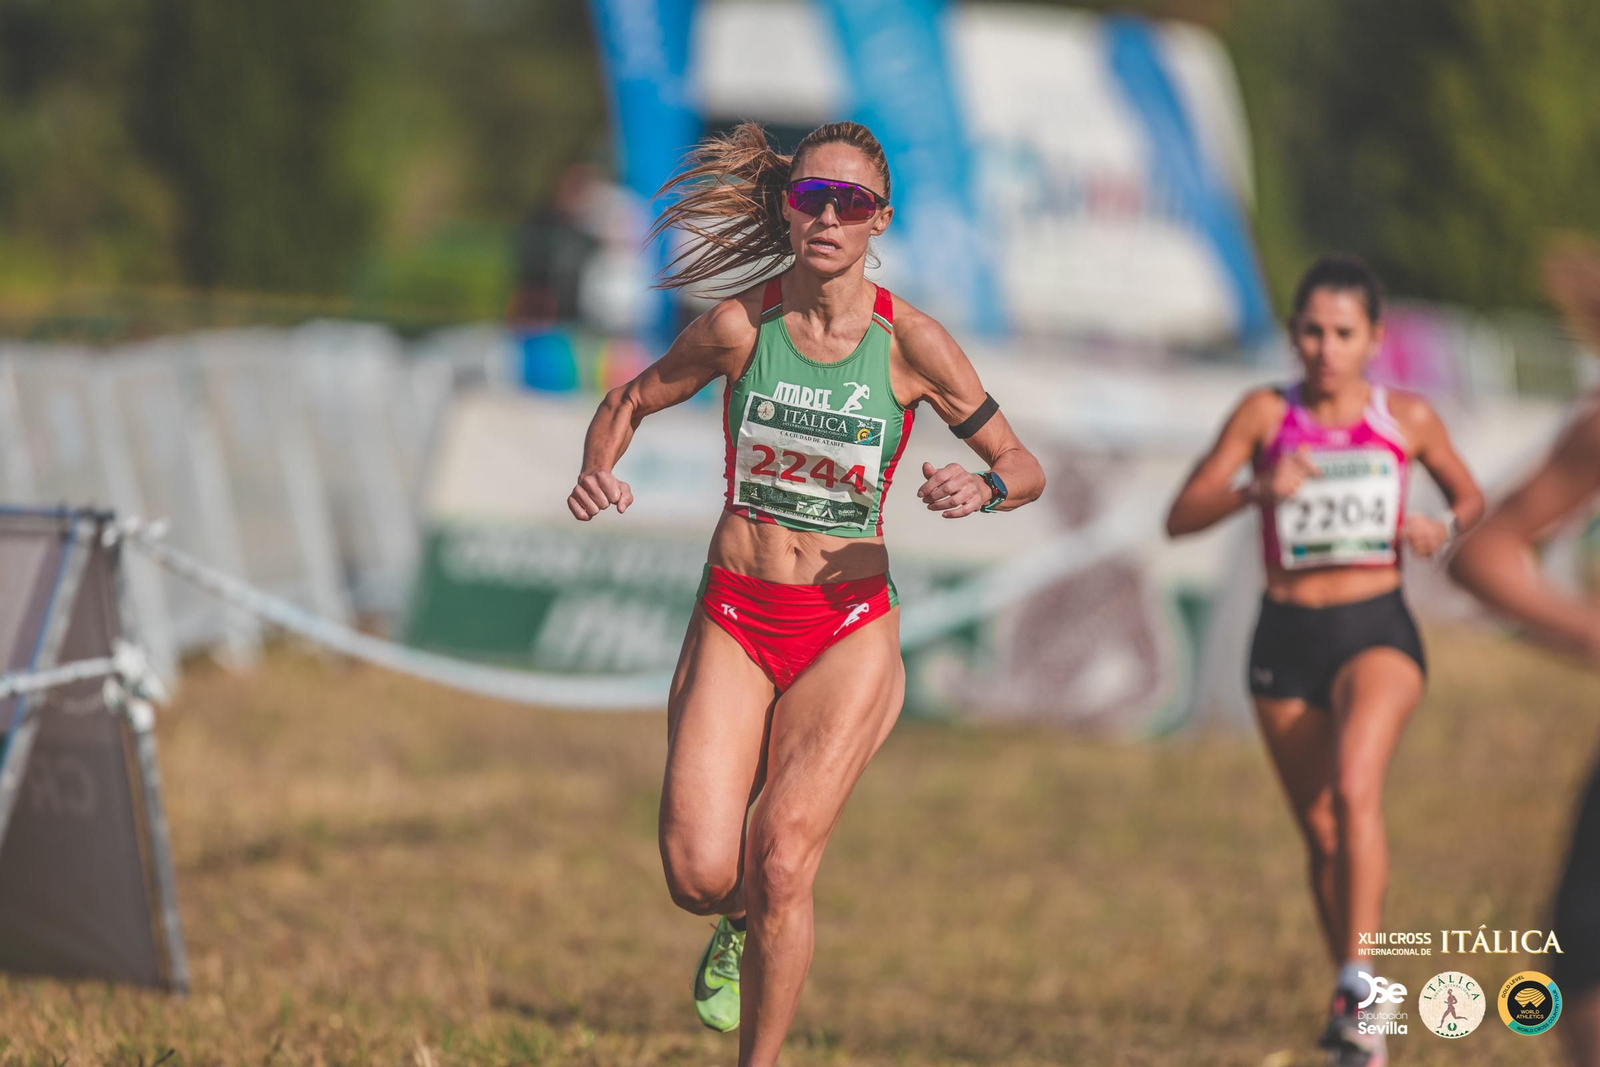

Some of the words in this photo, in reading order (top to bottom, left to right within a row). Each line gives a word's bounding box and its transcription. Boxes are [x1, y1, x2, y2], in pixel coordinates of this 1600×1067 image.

[783, 409, 848, 434] ITÁLICA
[790, 432, 812, 441] CIUDAD
[821, 439, 845, 448] ATARFE
[750, 444, 867, 495] 2244
[1294, 497, 1386, 532] 2204
